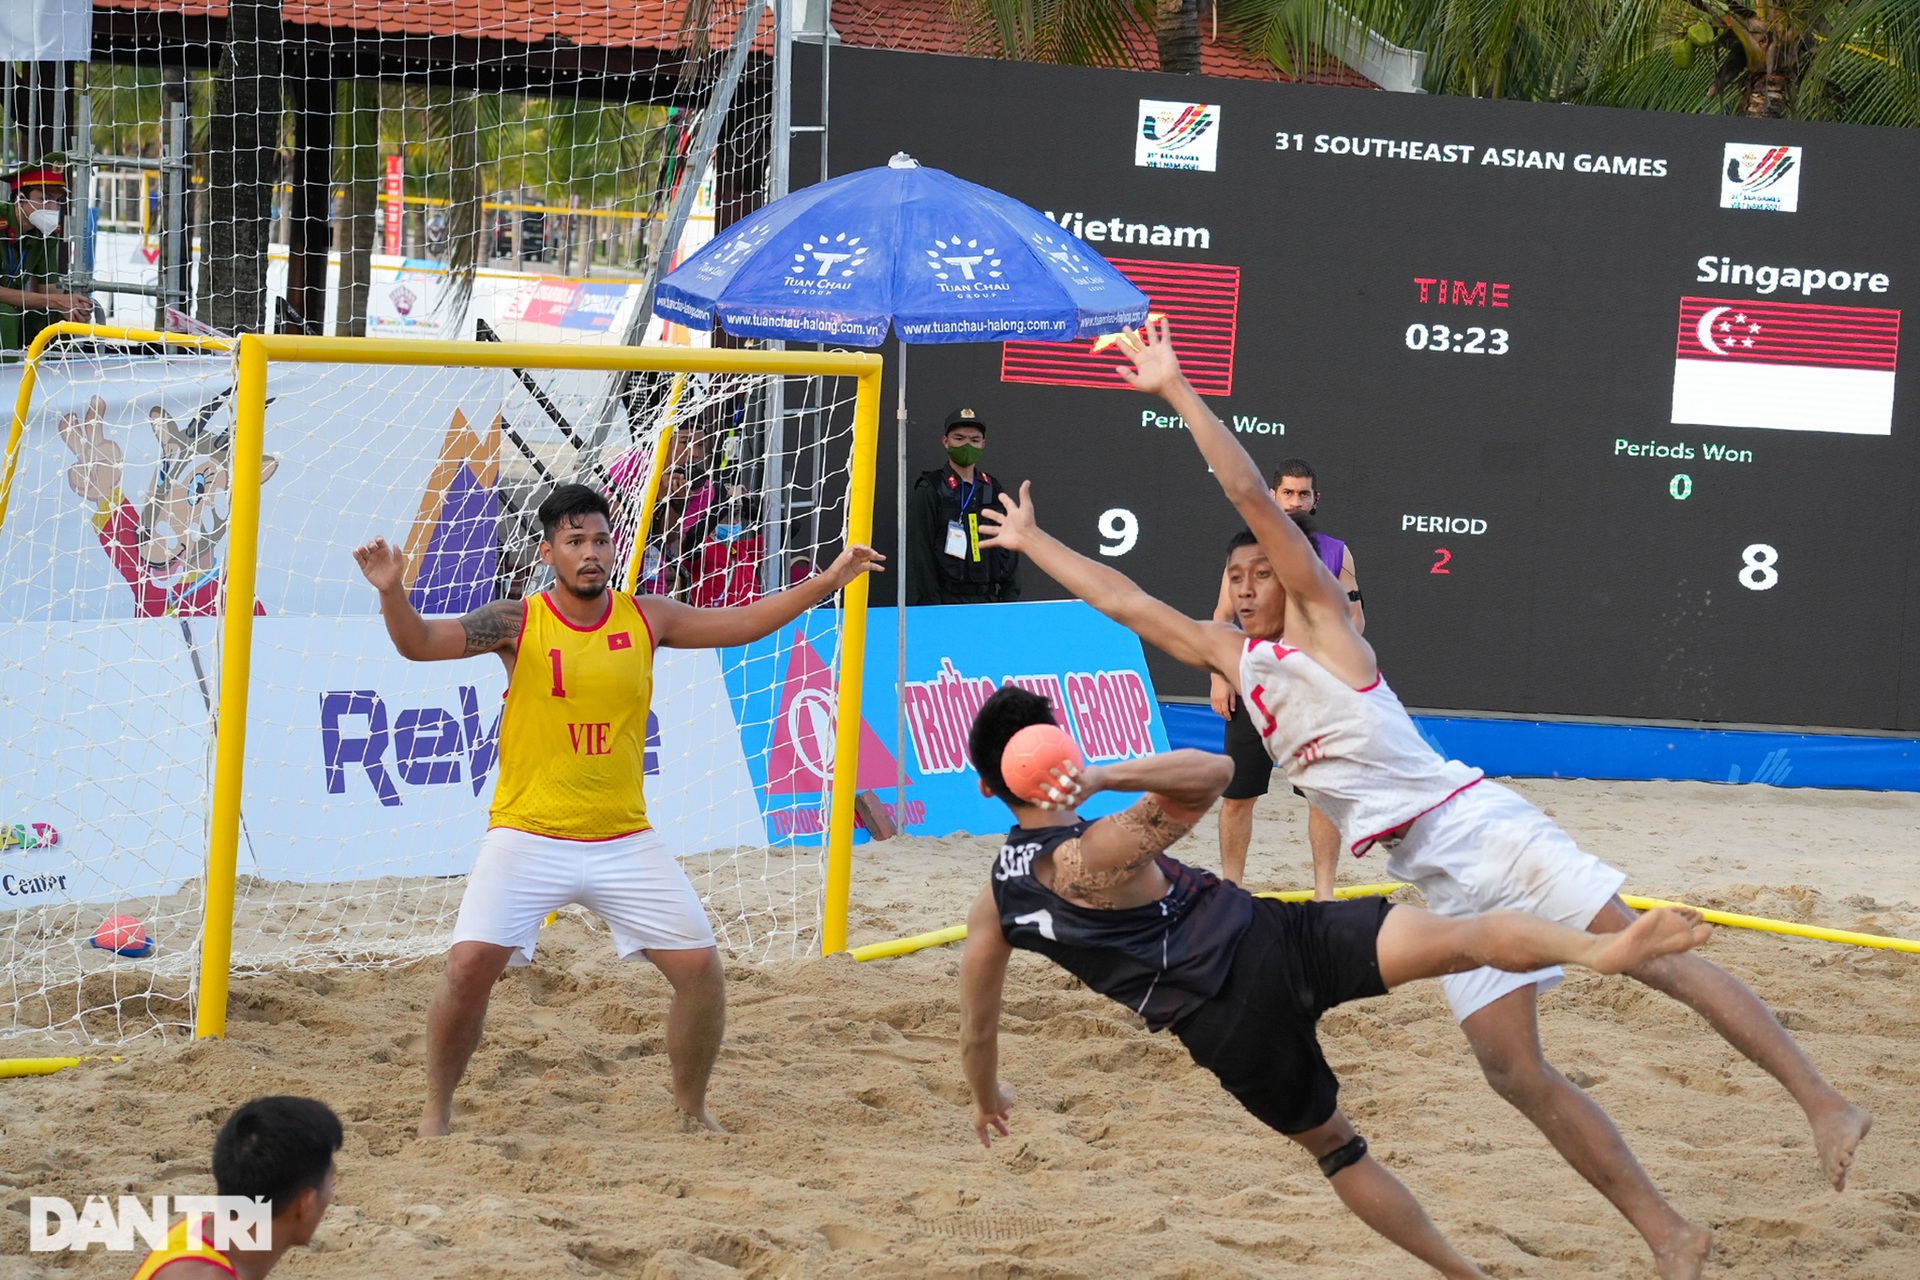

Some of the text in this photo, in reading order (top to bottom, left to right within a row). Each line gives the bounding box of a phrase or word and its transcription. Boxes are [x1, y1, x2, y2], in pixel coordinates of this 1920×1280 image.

[1275, 132, 1668, 178] 31 SOUTHEAST ASIAN GAMES
[783, 276, 851, 291] TUAN CHAU
[936, 281, 1010, 293] TUAN CHAU
[1696, 255, 1890, 296] Singapore
[793, 288, 832, 296] GROUP
[1413, 277, 1511, 308] TIME
[726, 313, 879, 336] www.tuanchau-halong.com.vn
[903, 317, 1066, 335] www.tuanchau-halong.com.vn
[1405, 323, 1510, 355] 03:23
[1233, 415, 1285, 435] Won
[1614, 438, 1753, 463] Periods Won
[1669, 473, 1693, 500] 0
[1098, 508, 1140, 557] 9
[1402, 514, 1488, 535] PERIOD
[1430, 548, 1452, 575] 2
[1738, 543, 1779, 591] 8
[548, 648, 566, 699] 1
[1065, 671, 1155, 760] GROUP
[567, 721, 612, 756] VIE
[2, 873, 67, 896] Center
